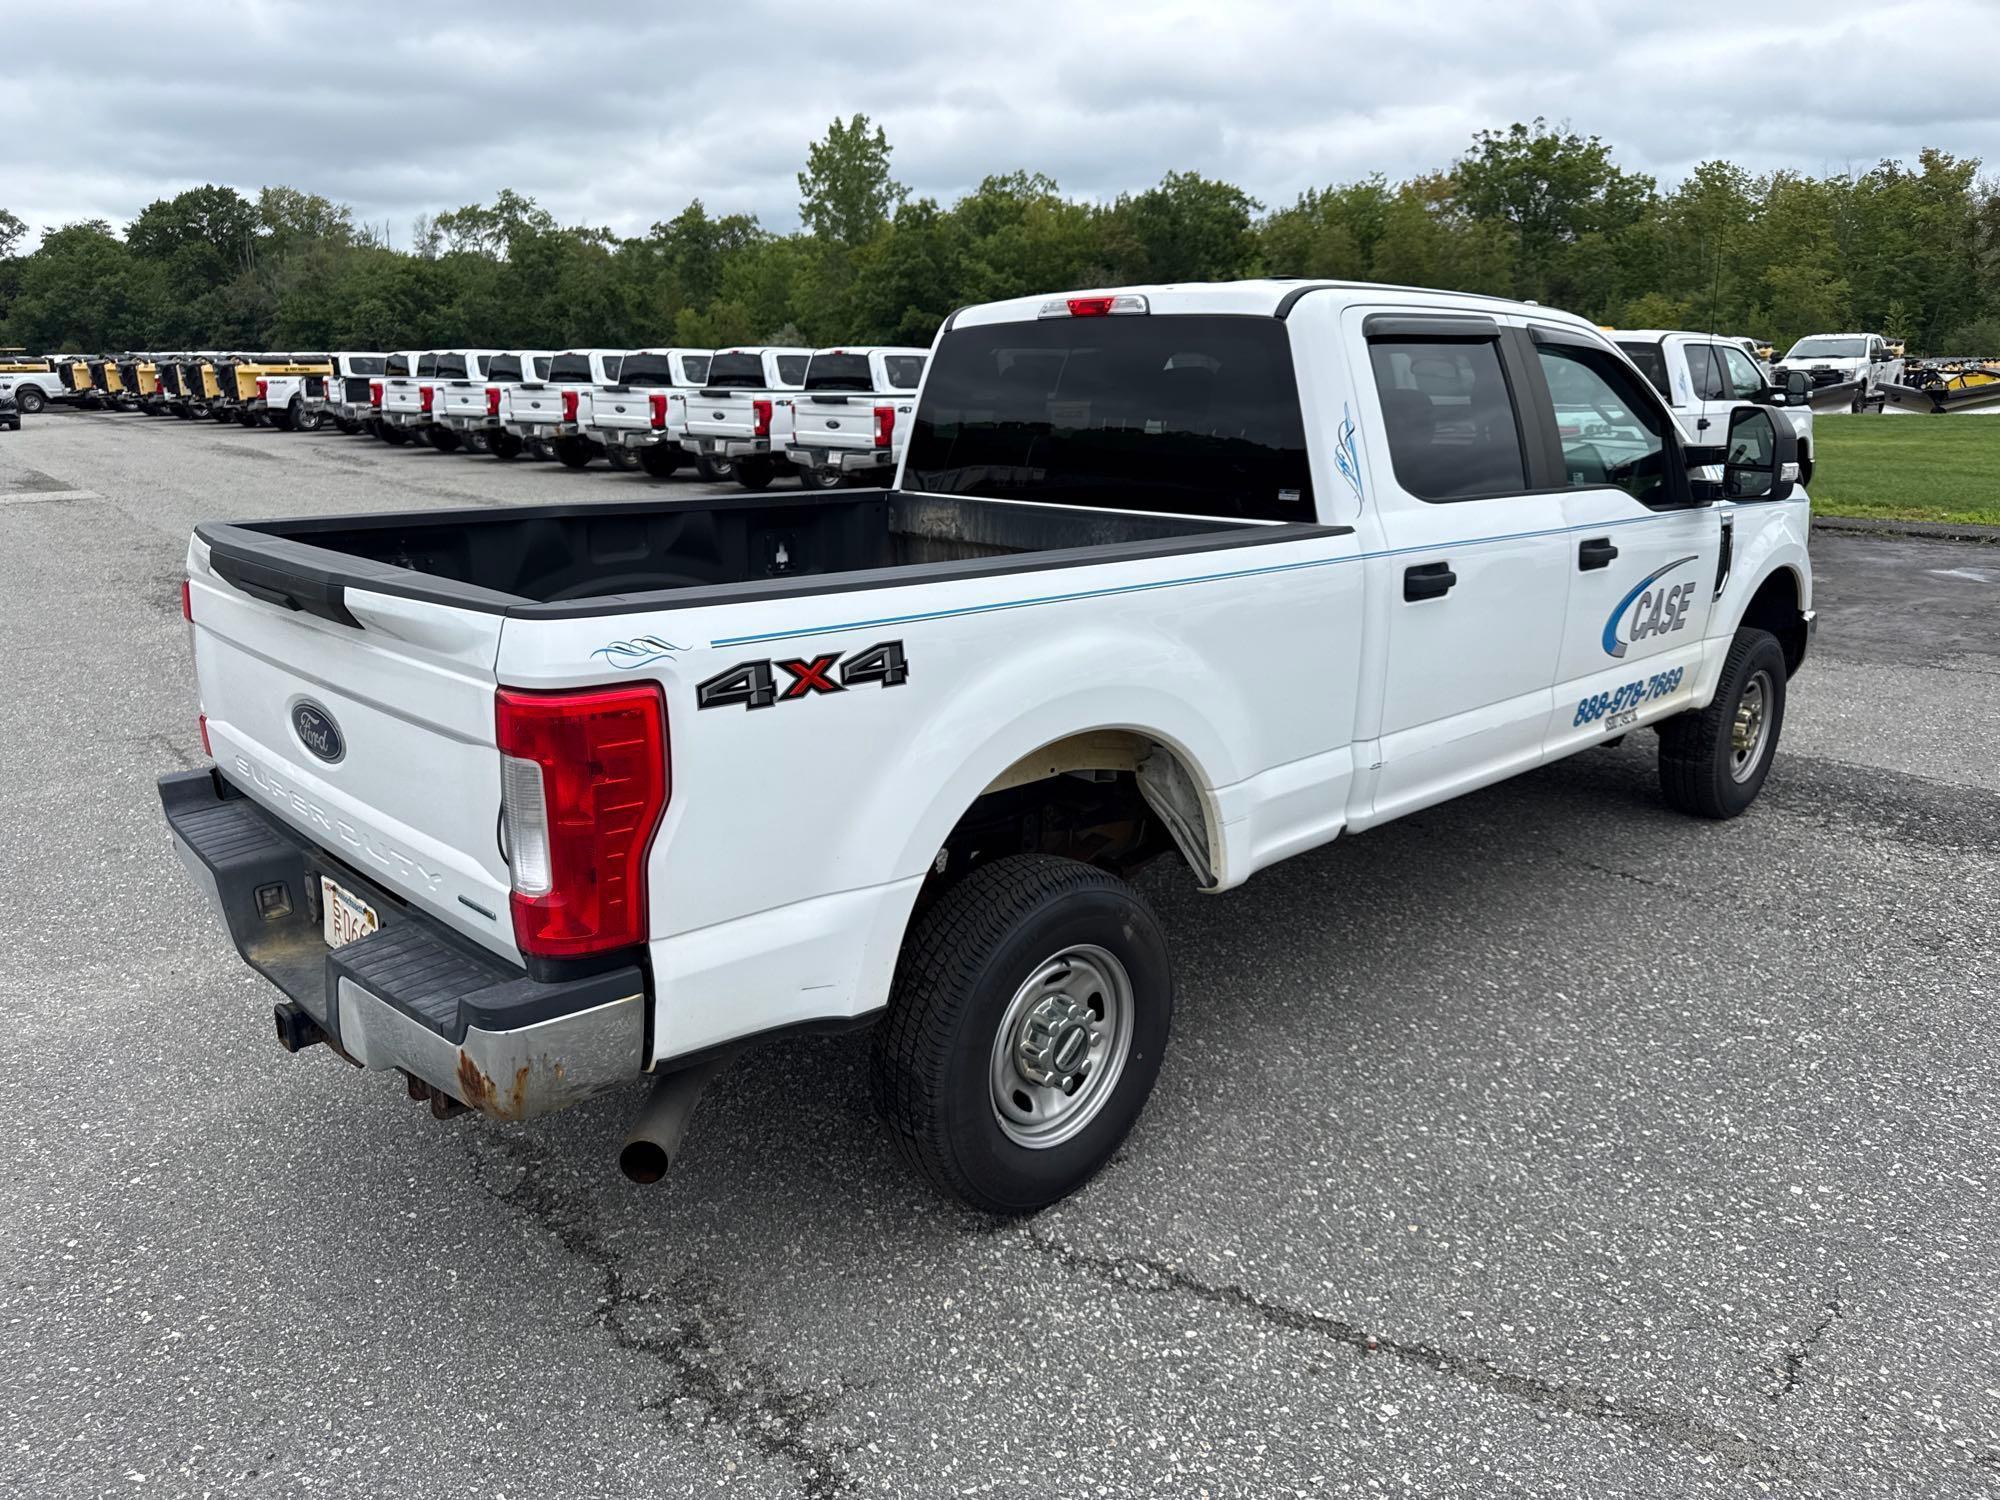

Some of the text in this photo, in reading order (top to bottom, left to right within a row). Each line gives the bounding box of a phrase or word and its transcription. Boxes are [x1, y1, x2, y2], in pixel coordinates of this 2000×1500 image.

[1630, 582, 1696, 642] CASE
[696, 639, 908, 711] 4X4
[1573, 666, 1684, 727] 888-978-7669
[299, 711, 329, 752] Ford
[235, 755, 442, 892] SUPER DUTY
